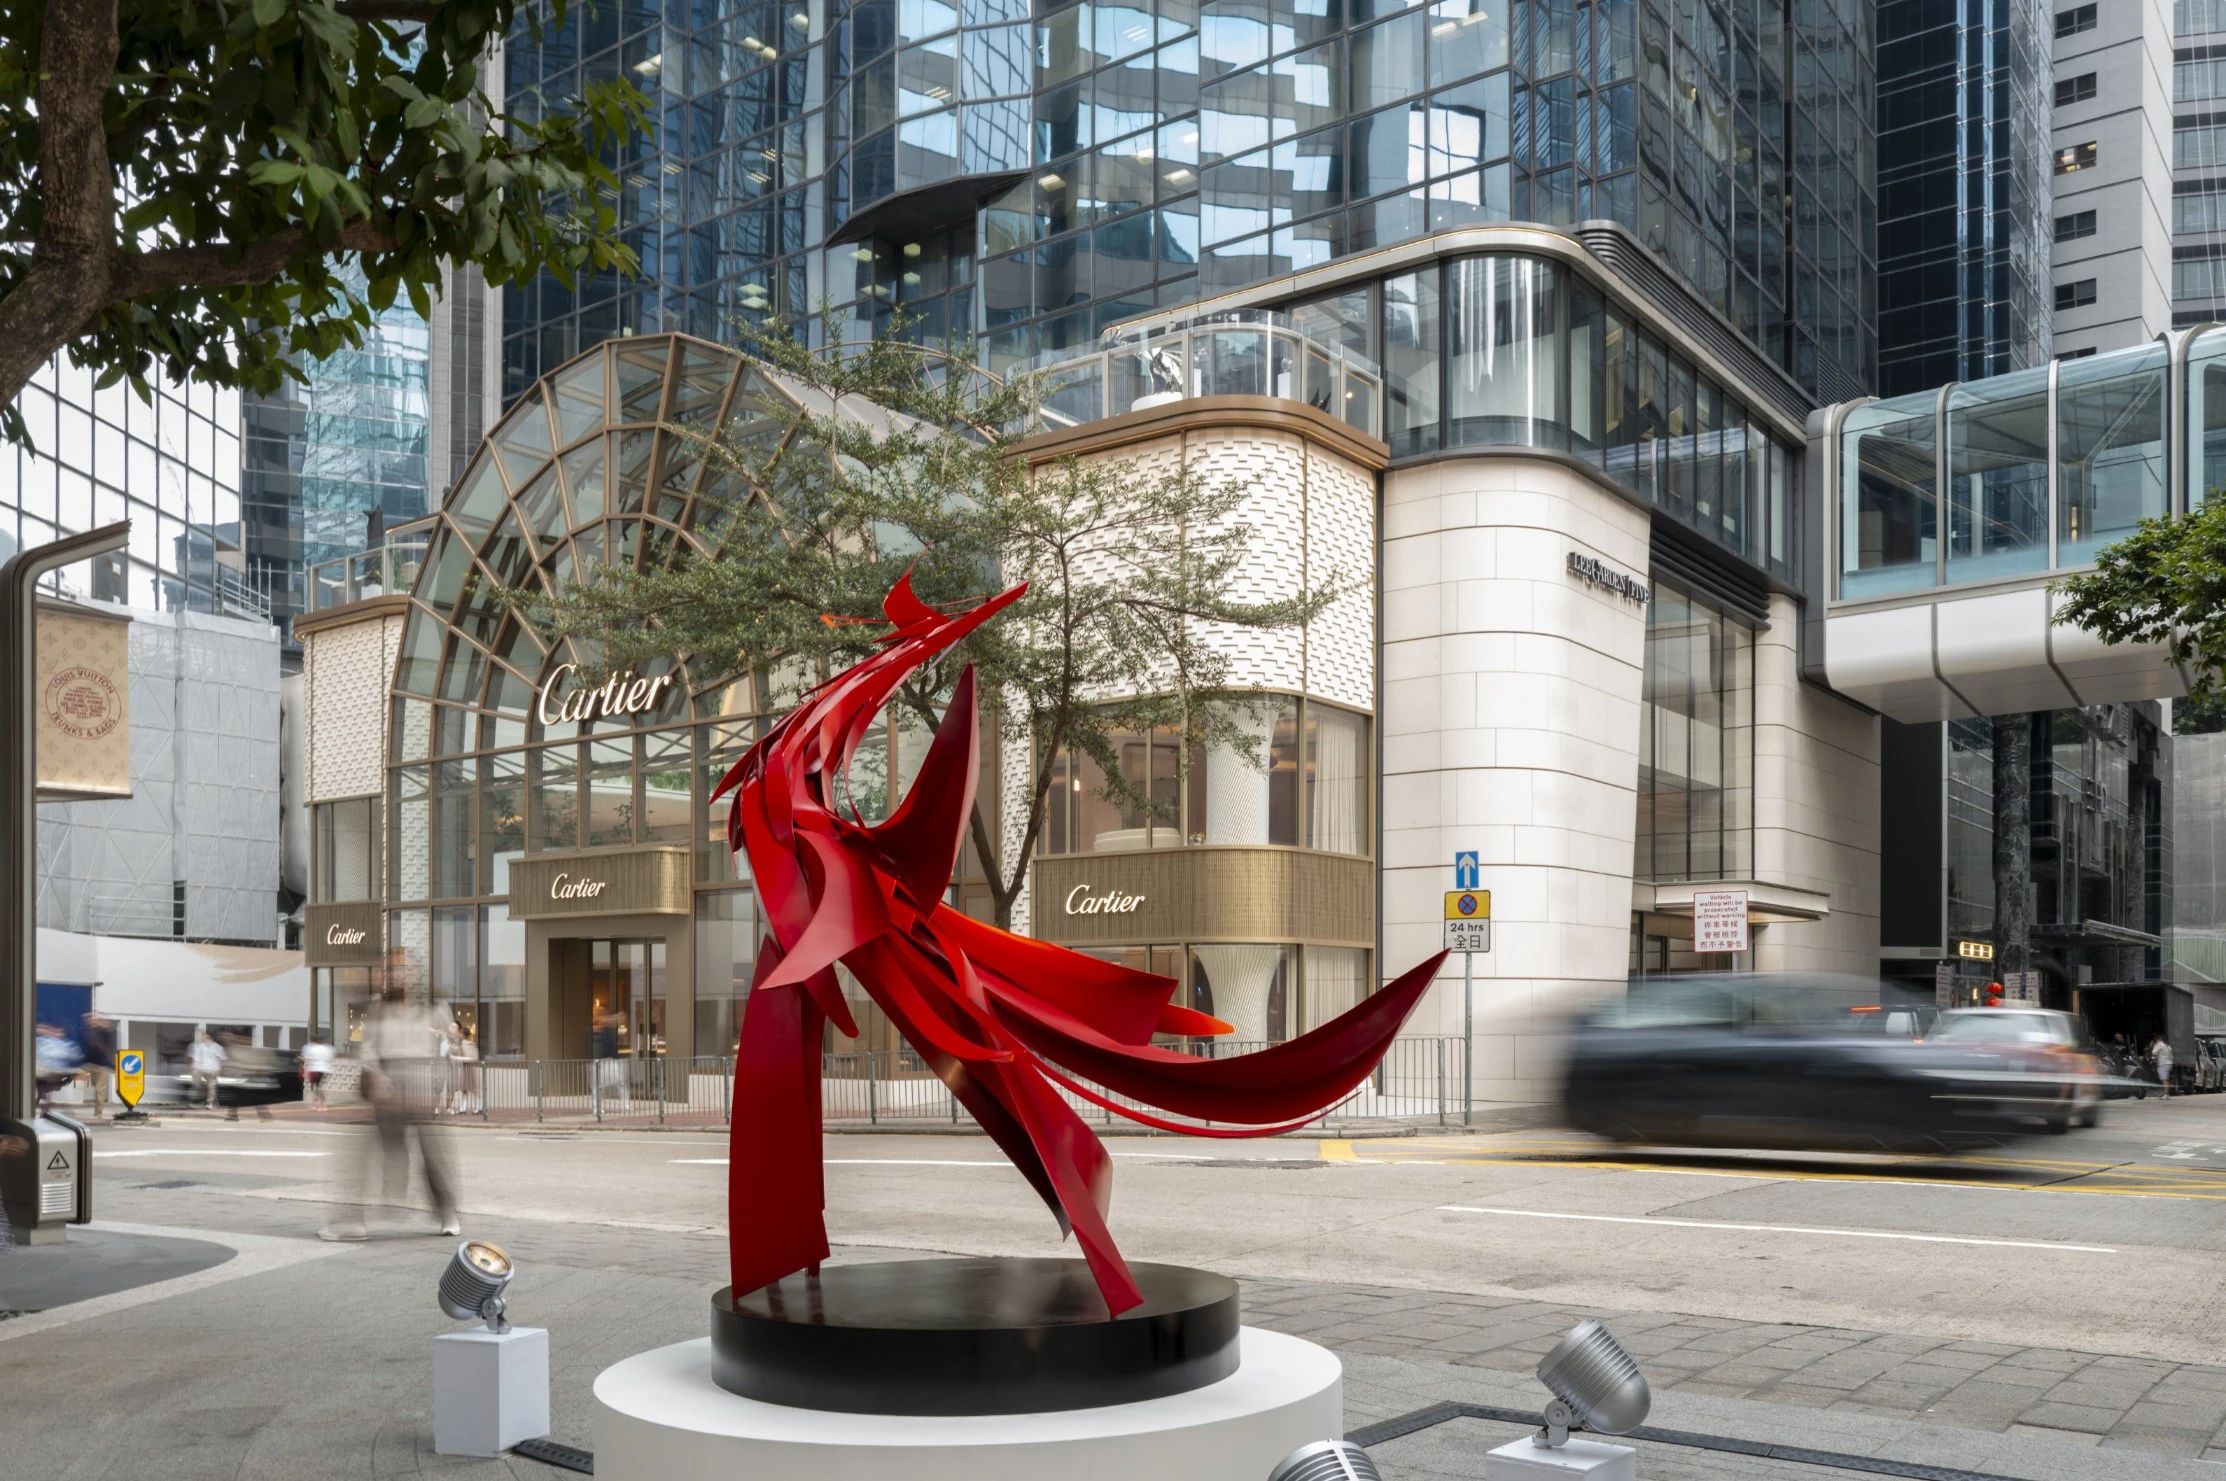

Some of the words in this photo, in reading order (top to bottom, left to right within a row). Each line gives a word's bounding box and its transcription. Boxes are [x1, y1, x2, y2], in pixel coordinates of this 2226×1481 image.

[1570, 552, 1592, 575] LEE
[1591, 559, 1626, 591] GARDEN
[1630, 579, 1650, 604] FIVE
[51, 671, 75, 688] LOUIS
[77, 670, 114, 694] VUITTON
[538, 663, 671, 725] Cartier
[52, 712, 83, 736] TRUNKS
[87, 729, 93, 737] &
[95, 719, 116, 735] BAGS
[551, 873, 606, 900] Cartier
[1065, 884, 1146, 915] Cartier
[327, 923, 366, 945] Cartier
[1450, 923, 1465, 933] 24
[1467, 922, 1484, 932] hrs
[1454, 934, 1481, 949] 全日
